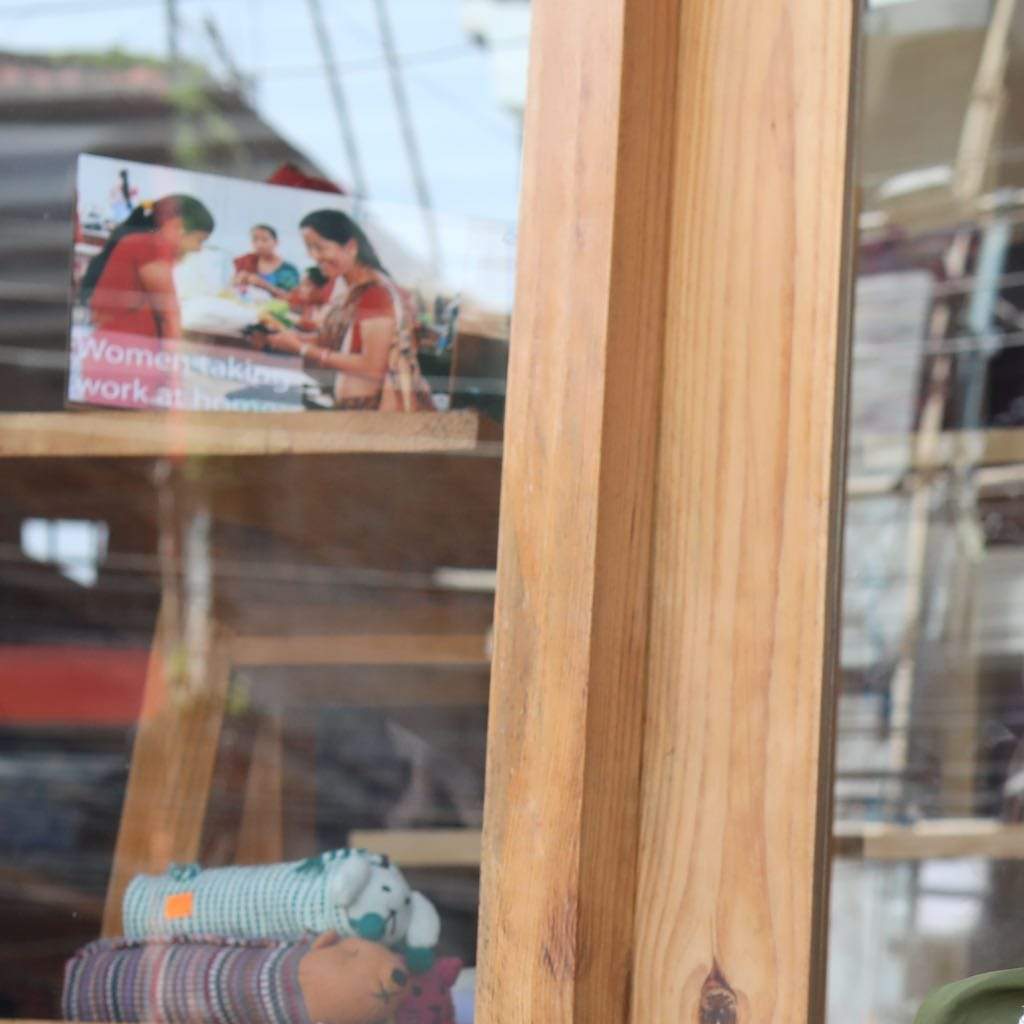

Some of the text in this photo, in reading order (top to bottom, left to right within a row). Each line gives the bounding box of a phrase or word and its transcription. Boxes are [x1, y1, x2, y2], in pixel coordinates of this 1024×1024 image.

[76, 335, 189, 377] Women
[78, 377, 149, 404] work
[157, 385, 185, 410] at
